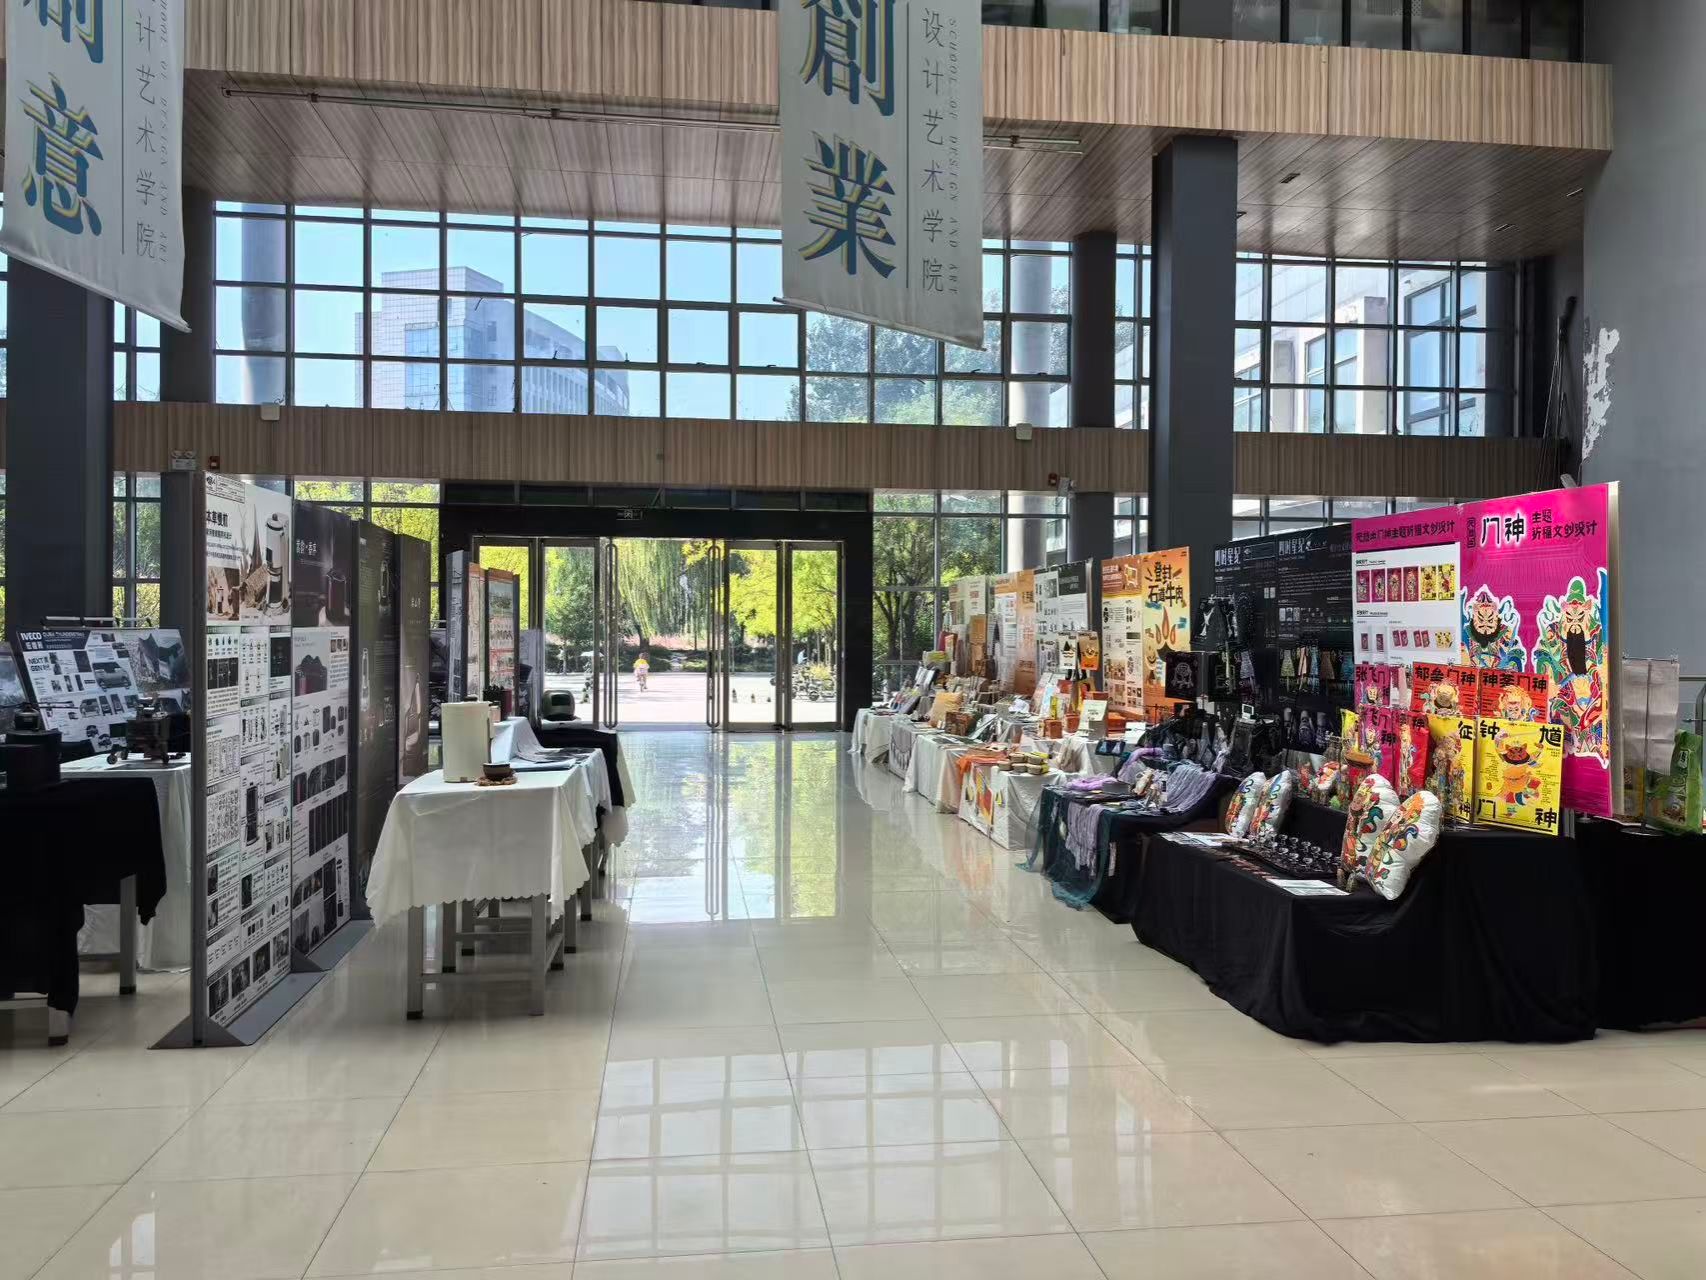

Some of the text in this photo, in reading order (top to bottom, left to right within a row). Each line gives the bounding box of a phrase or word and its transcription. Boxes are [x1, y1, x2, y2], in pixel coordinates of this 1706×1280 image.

[921, 7, 944, 292] 设计艺术学院
[1532, 509, 1552, 523] 主题
[1481, 512, 1525, 544] 门神
[1532, 520, 1597, 540] 祈福文创设计
[20, 632, 42, 641] IVECO
